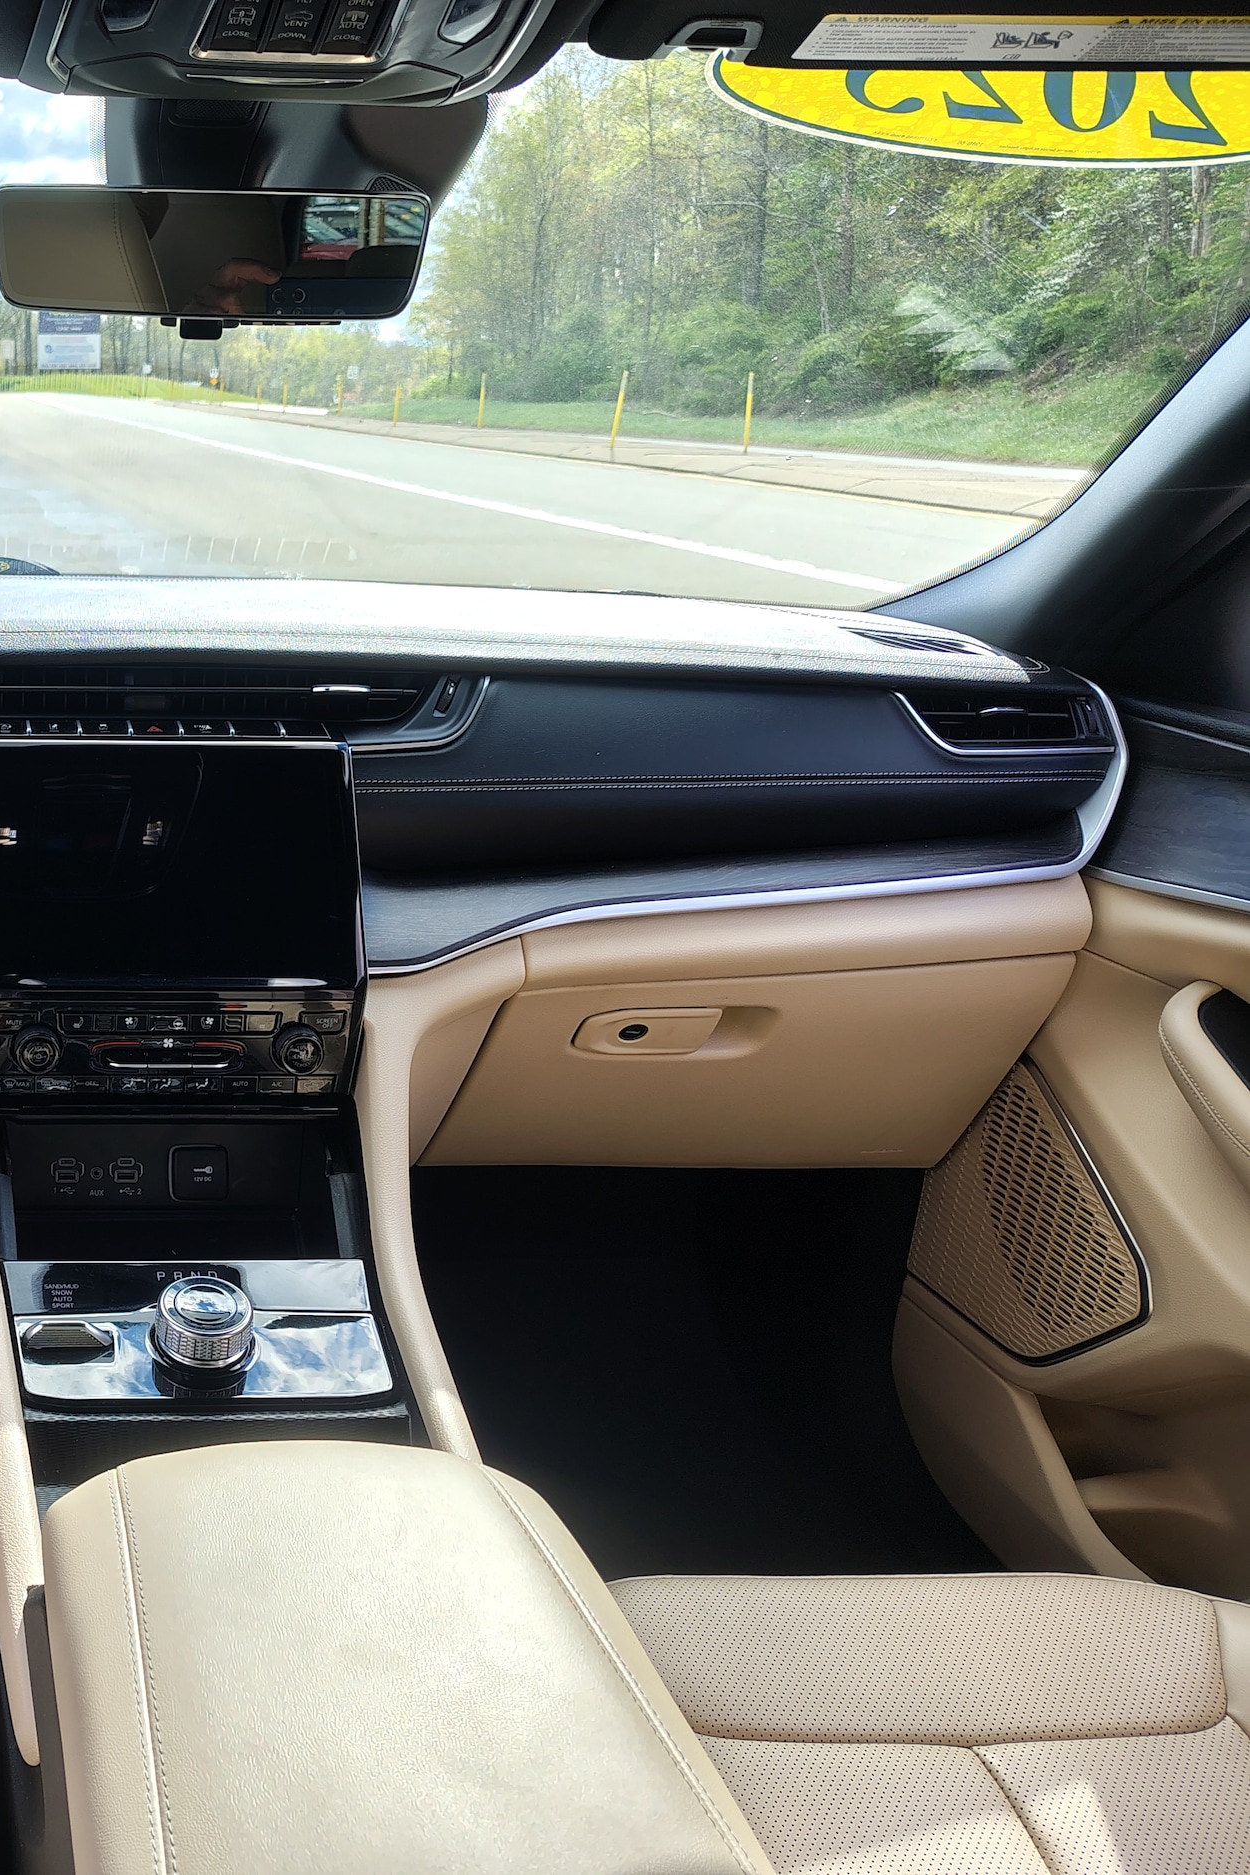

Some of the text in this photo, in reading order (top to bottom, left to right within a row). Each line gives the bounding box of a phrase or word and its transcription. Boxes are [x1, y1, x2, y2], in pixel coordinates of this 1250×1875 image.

[227, 18, 253, 26] AUTO
[338, 22, 365, 30] AUTO
[222, 30, 251, 38] CLOSE
[277, 32, 307, 40] DOWN
[156, 1271, 166, 1281] P
[174, 1271, 182, 1280] R
